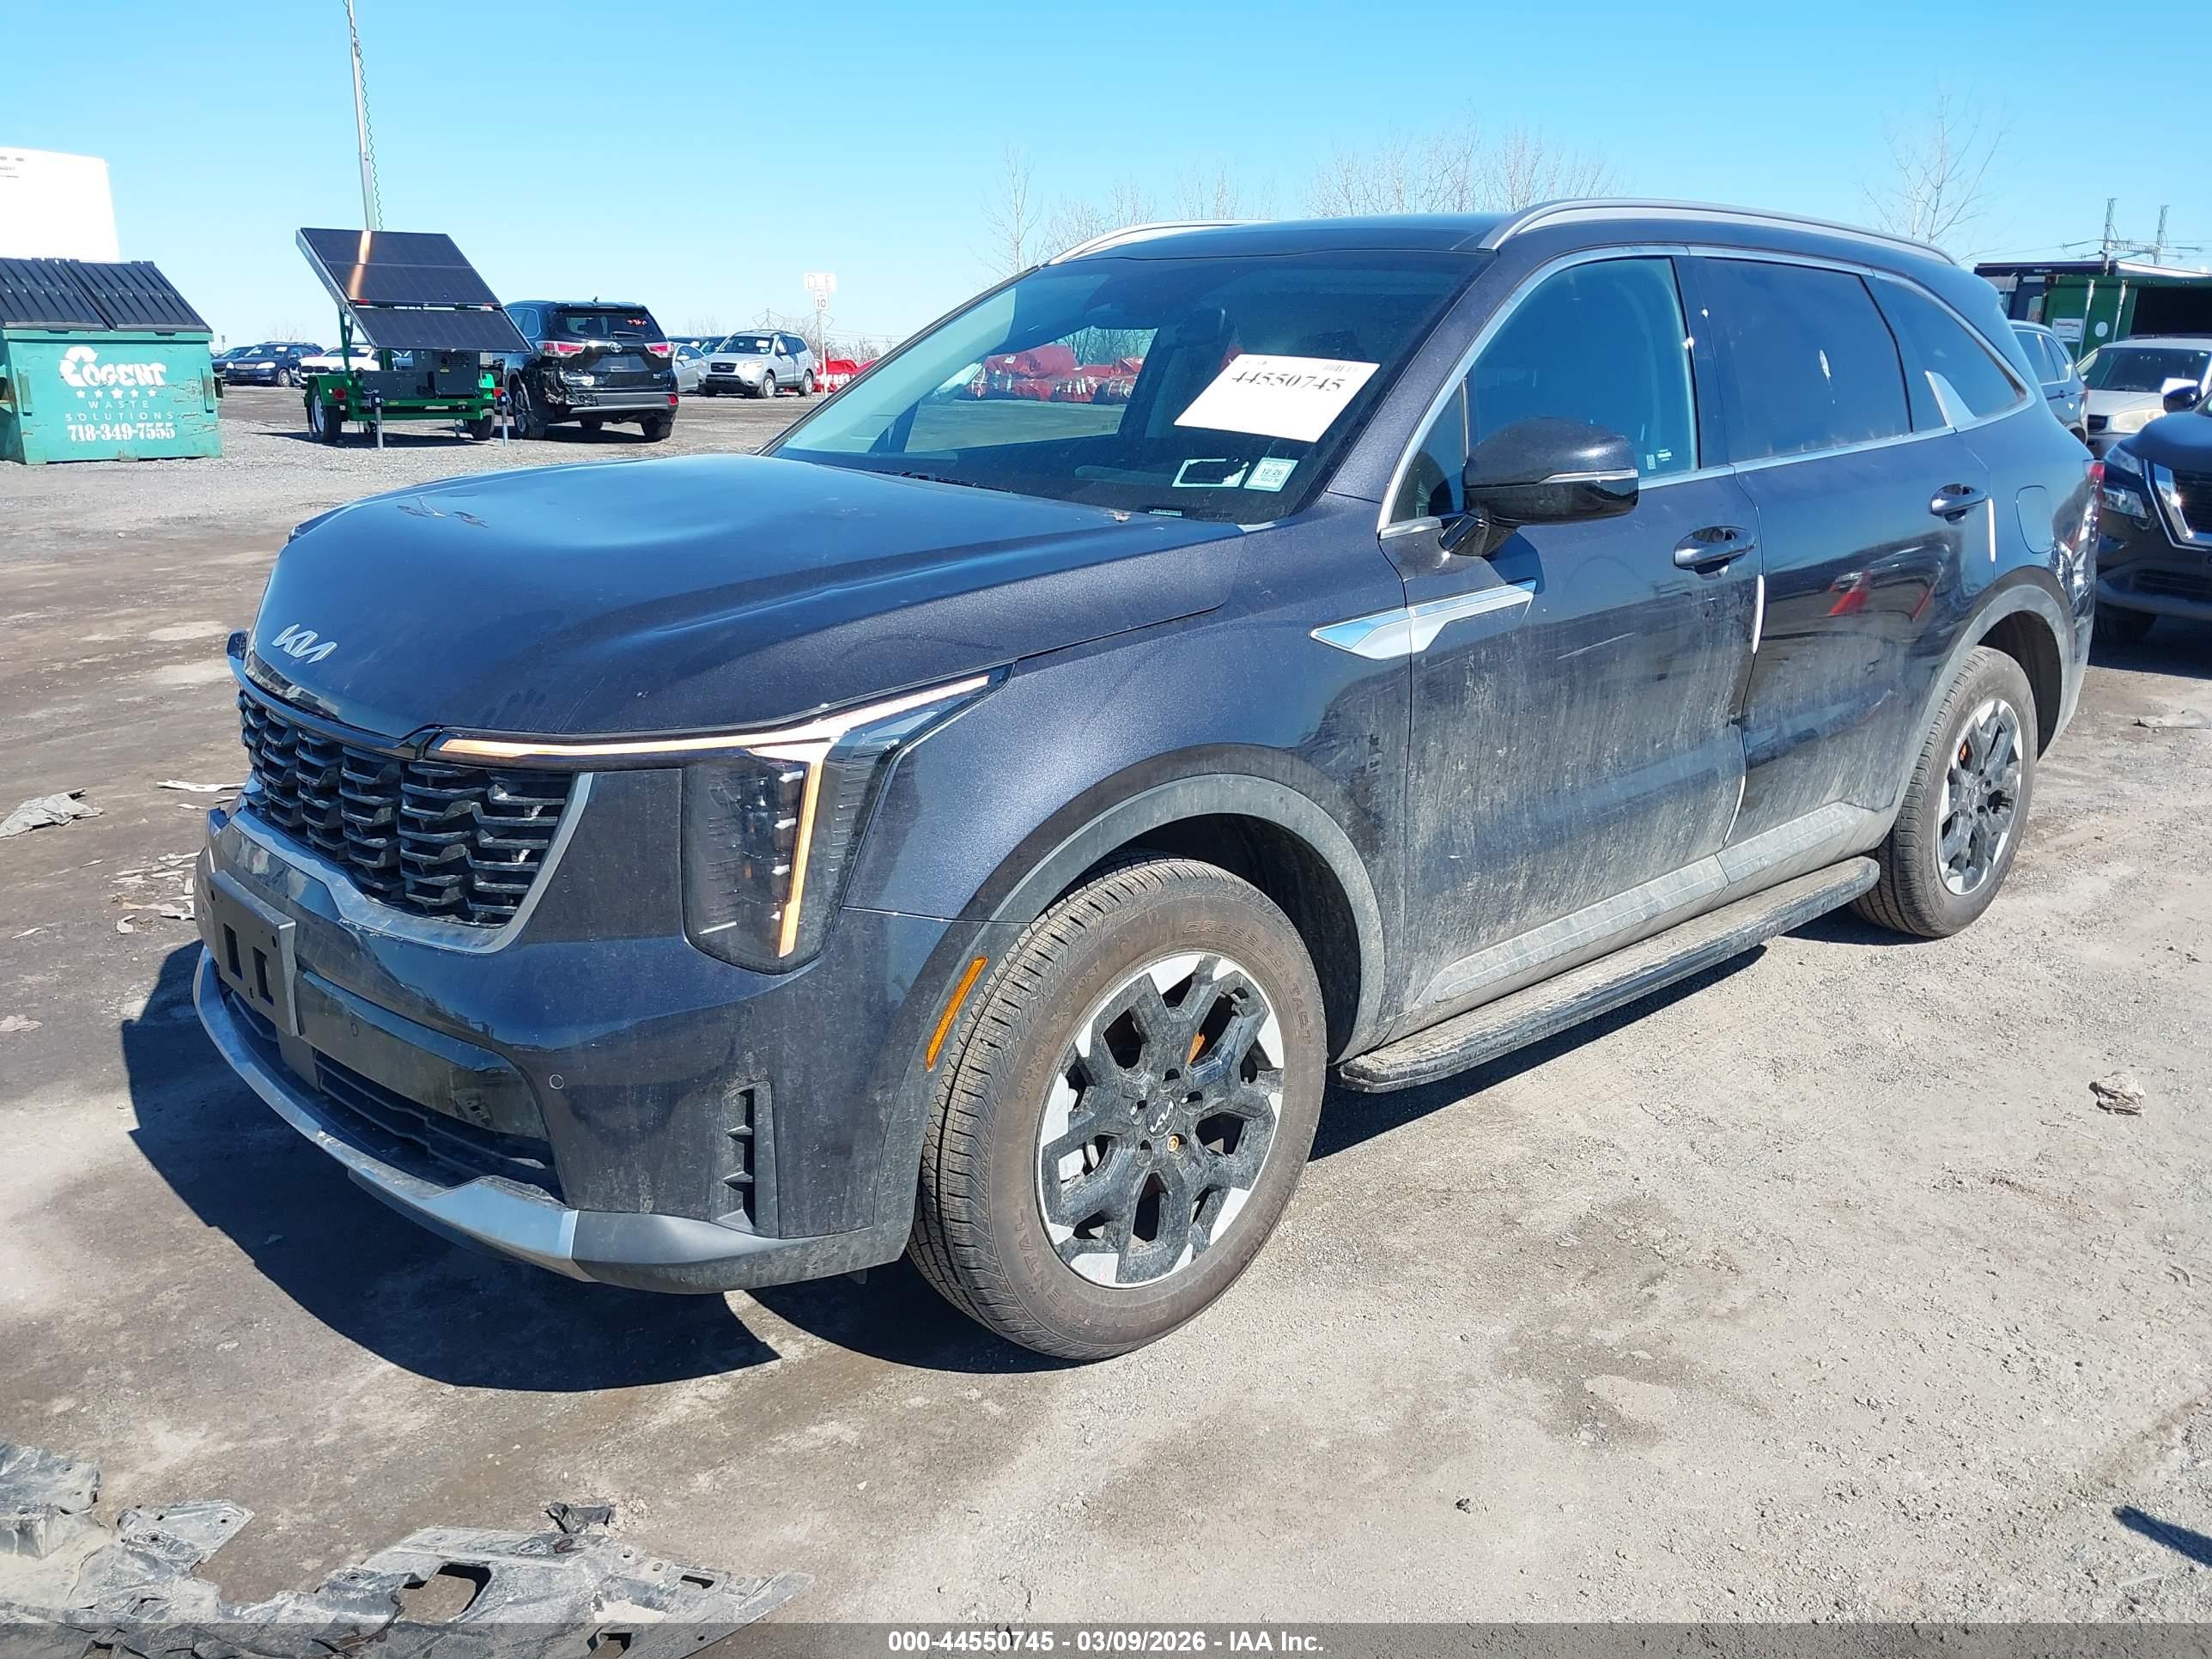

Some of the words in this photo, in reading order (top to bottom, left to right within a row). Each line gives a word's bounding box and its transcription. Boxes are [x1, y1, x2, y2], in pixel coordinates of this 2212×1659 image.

[817, 299, 826, 308] 10
[1231, 371, 1346, 392] 44550745
[88, 400, 149, 410] WASTE
[65, 412, 173, 422] SOLUTIONS
[67, 422, 176, 441] 718-349-7555
[271, 623, 337, 664] KIA
